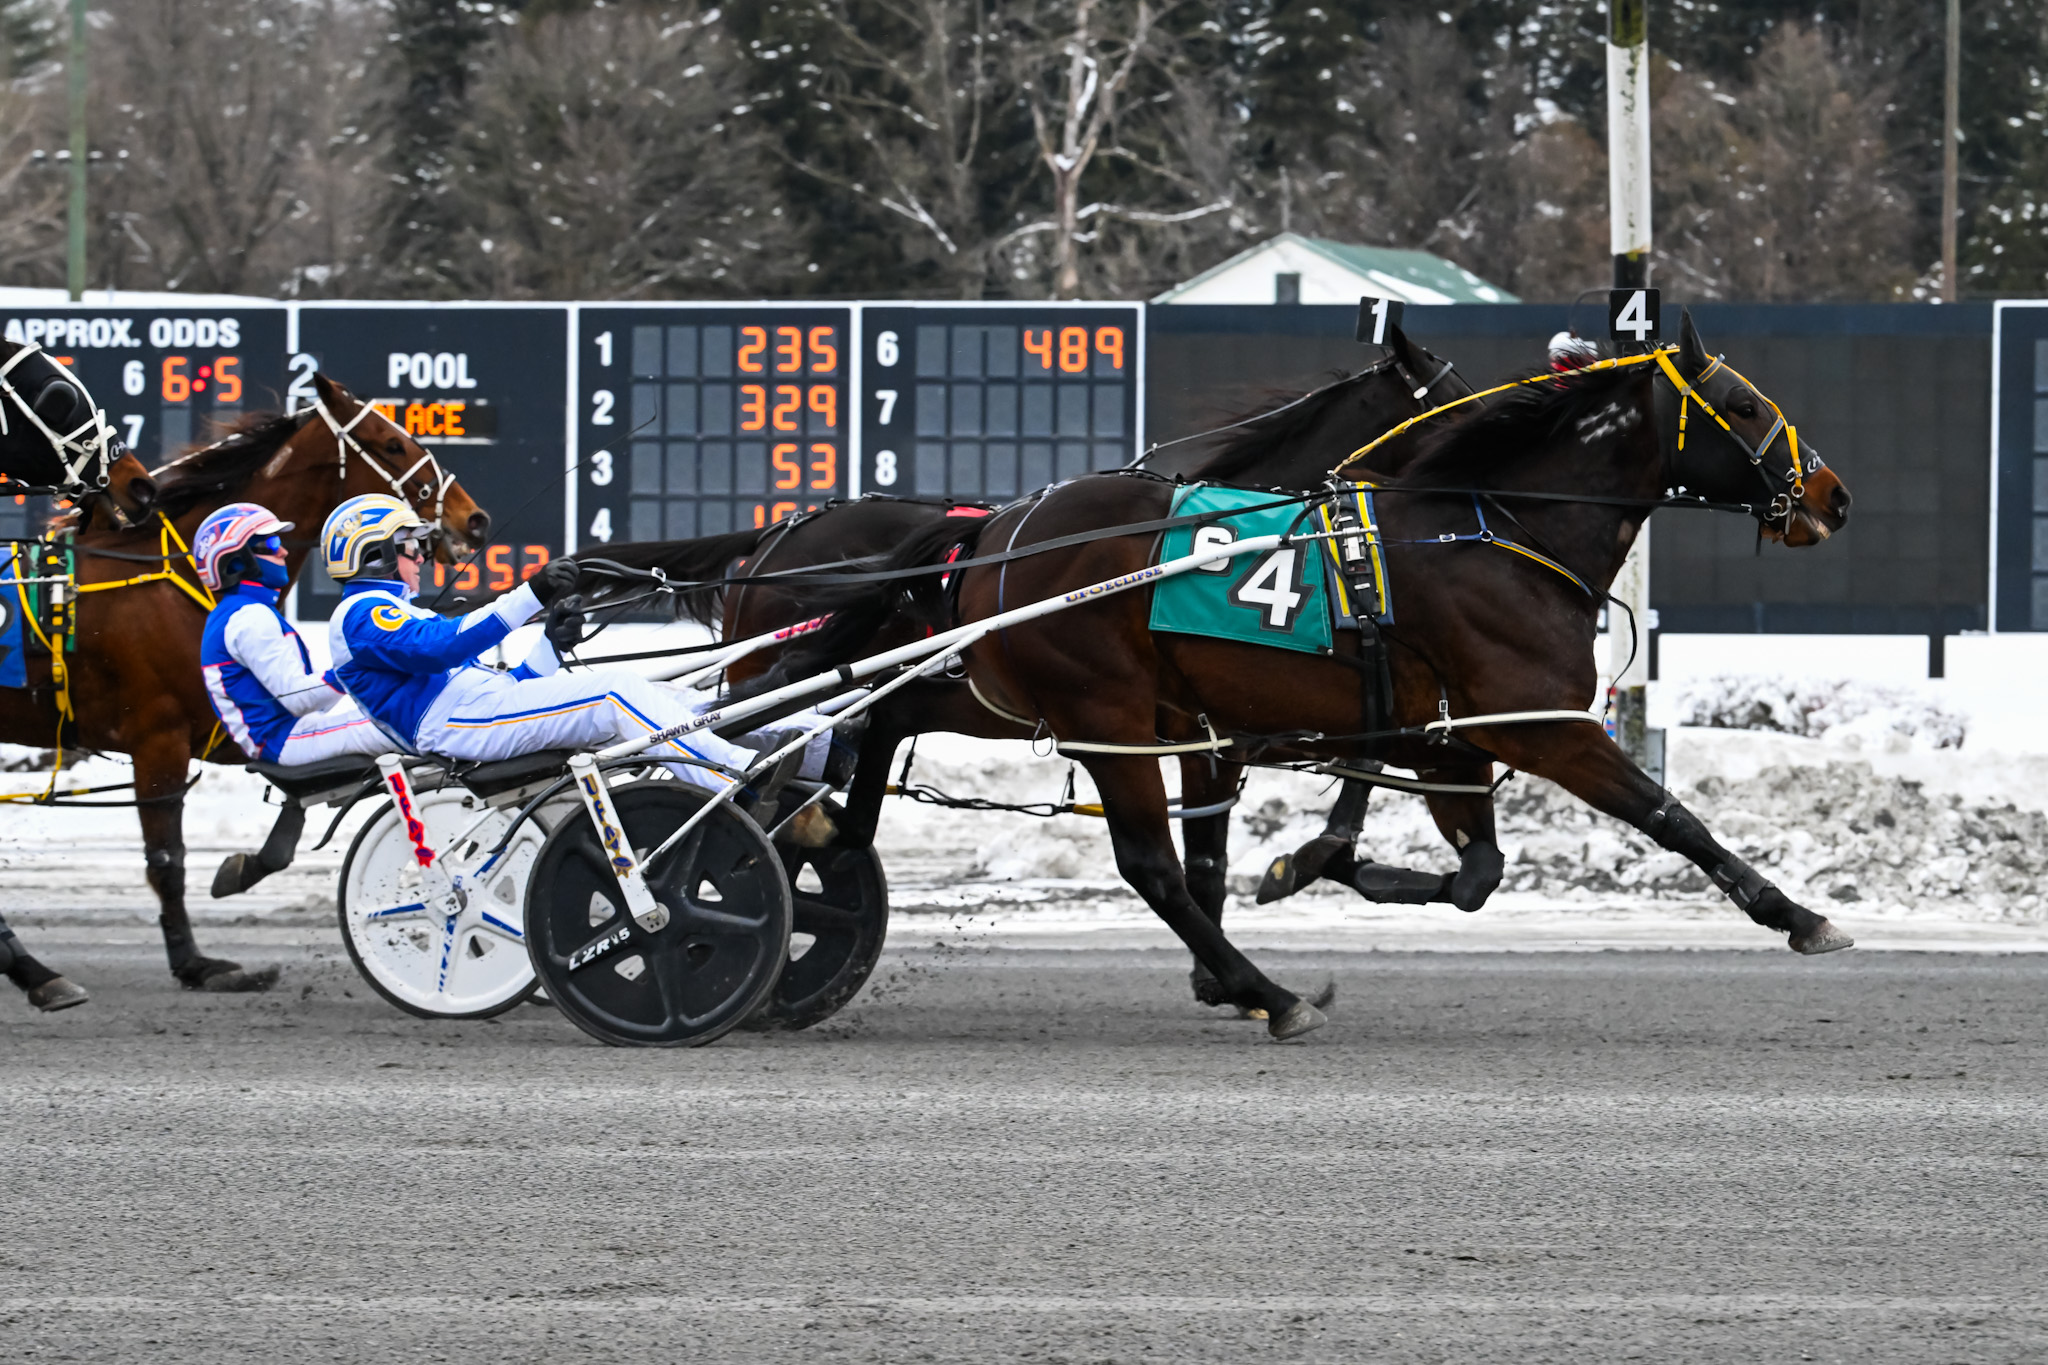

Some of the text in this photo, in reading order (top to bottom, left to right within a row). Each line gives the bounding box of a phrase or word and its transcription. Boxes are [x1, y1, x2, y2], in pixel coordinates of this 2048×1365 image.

[4, 317, 241, 348] APPROX. ODDS
[1371, 299, 1389, 345] 1
[1615, 290, 1653, 341] 4
[594, 326, 837, 373] 1 235
[876, 326, 1124, 373] 6 489
[123, 360, 146, 396] 6
[287, 353, 319, 397] 2
[388, 352, 478, 389] POOL
[371, 402, 466, 436] ACE
[591, 385, 837, 431] 2 329
[874, 389, 898, 426] 7
[121, 414, 145, 449] 7
[590, 443, 837, 490] 3 53
[874, 449, 898, 487] 8
[590, 507, 613, 544] 4
[1193, 526, 1233, 572] 6
[1238, 549, 1301, 627] 4
[371, 605, 412, 632] G
[649, 711, 722, 744] SHAWN GRAY
